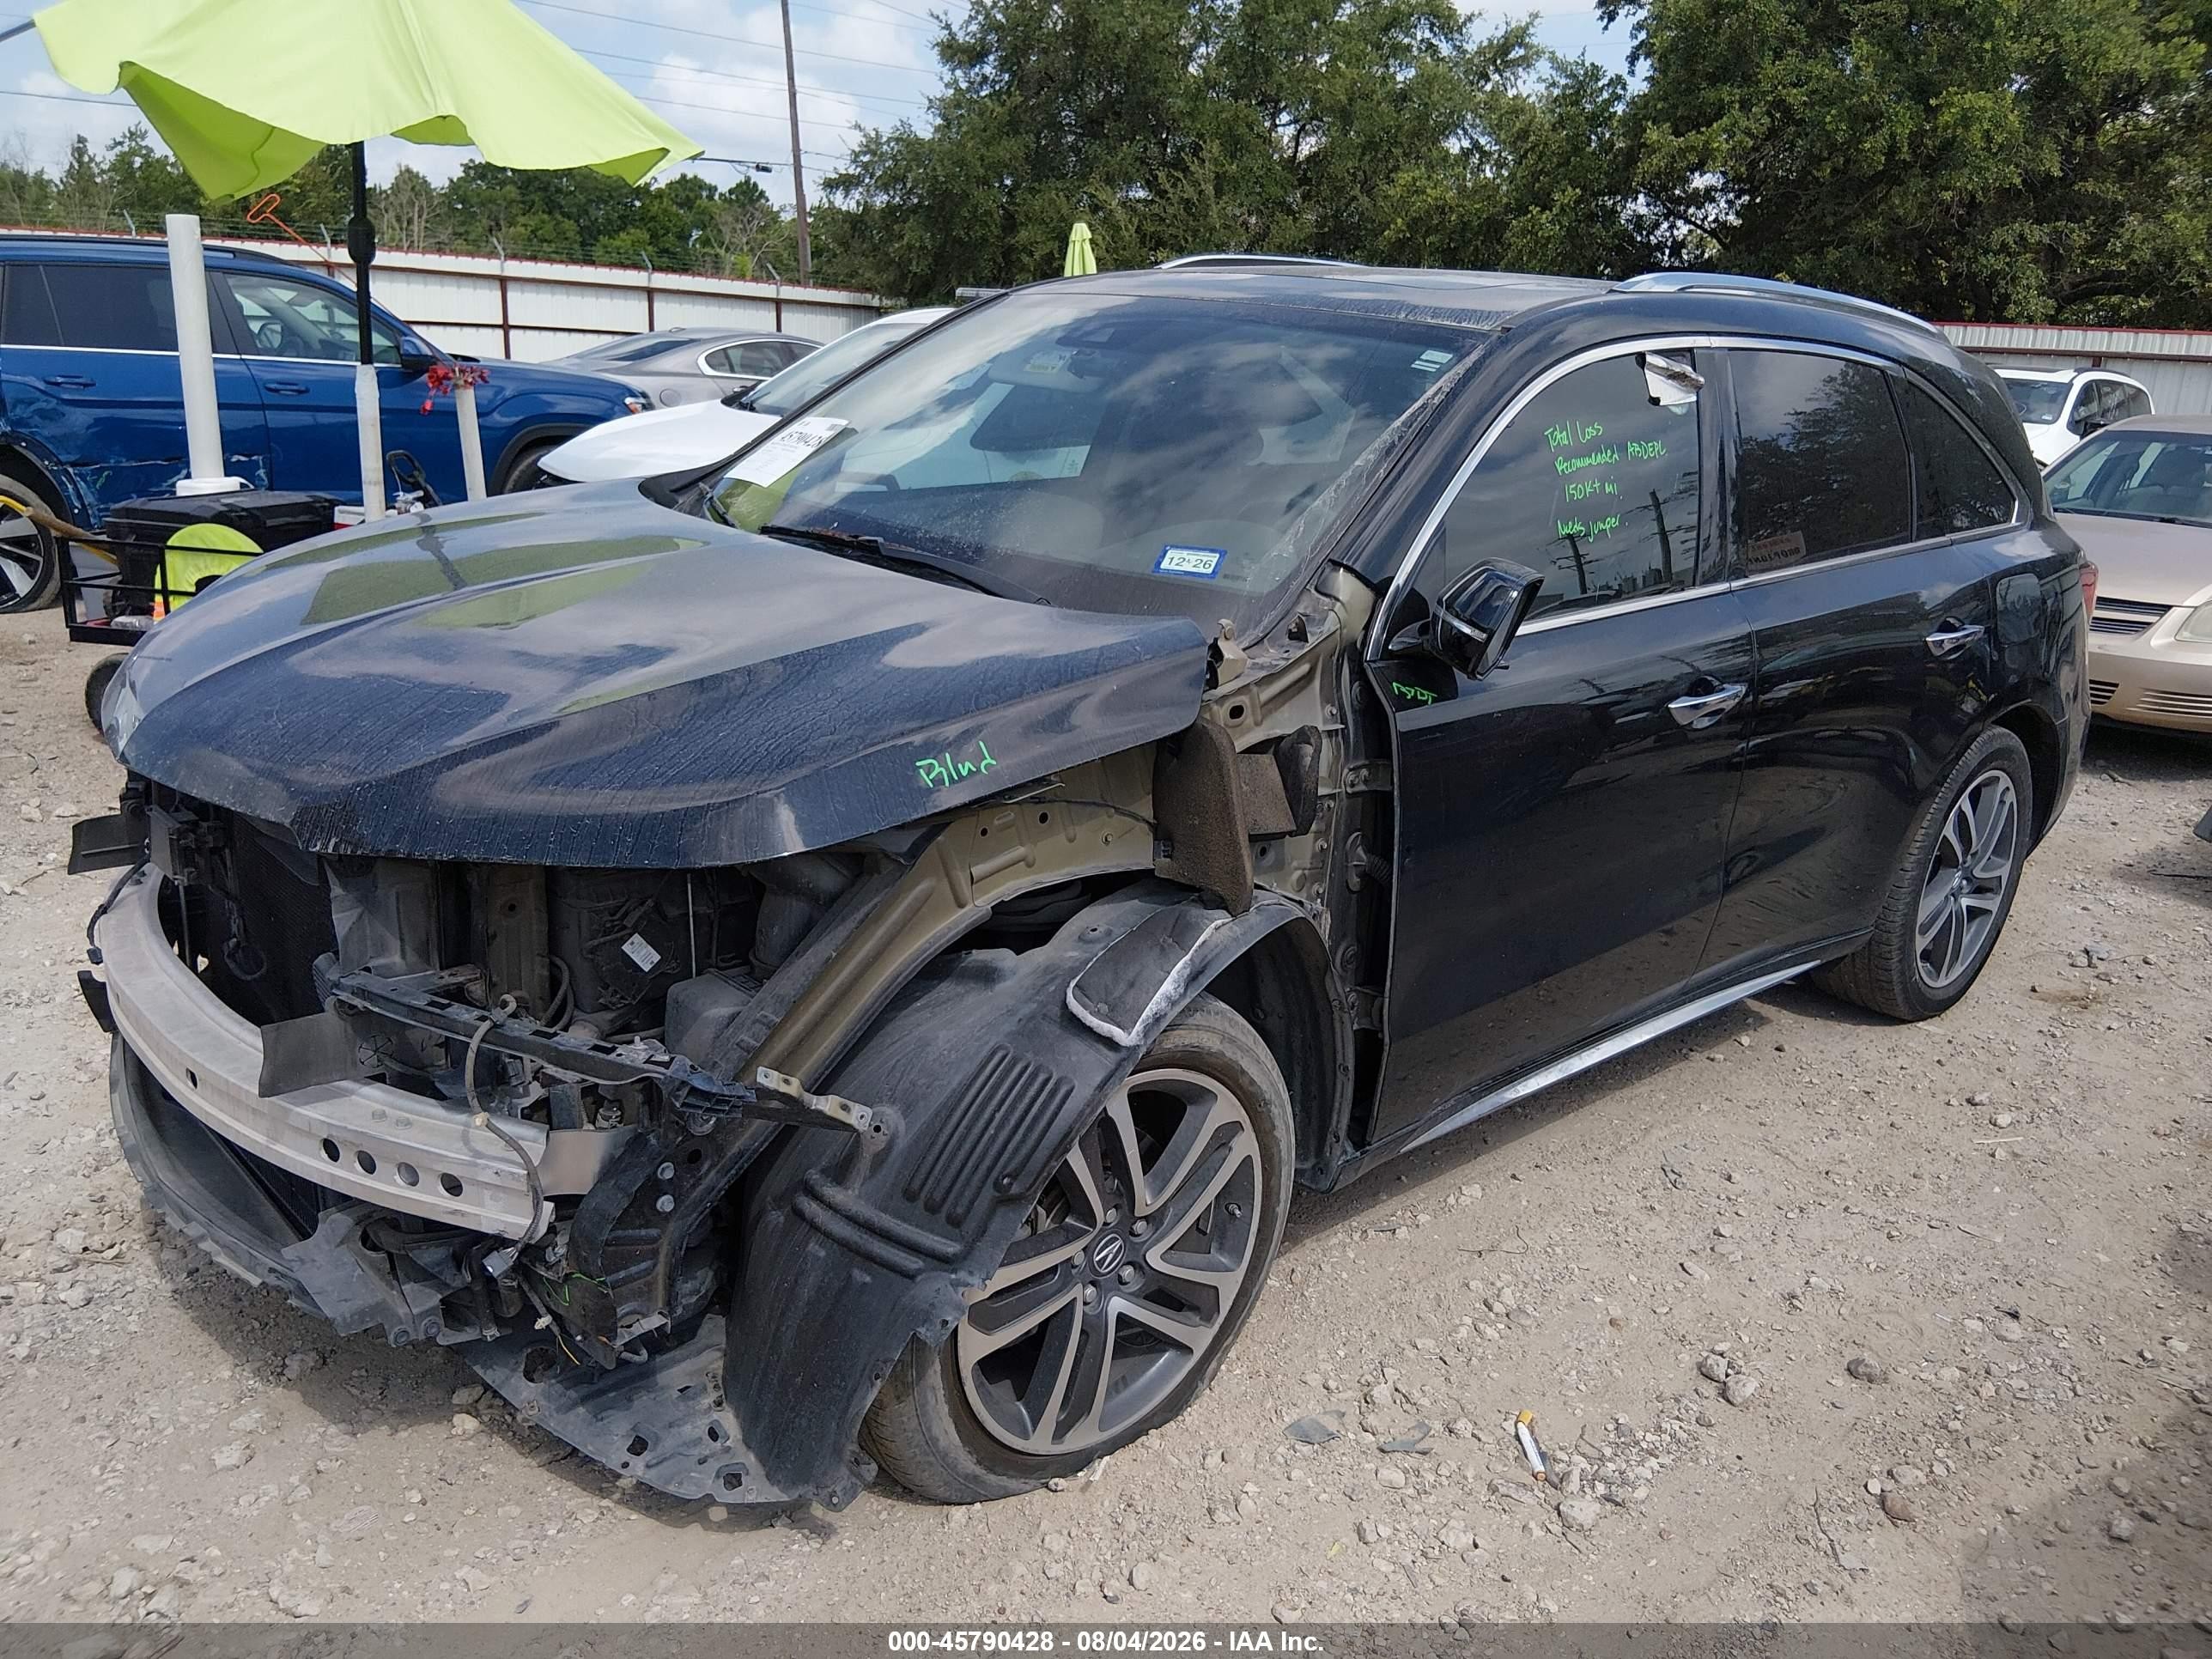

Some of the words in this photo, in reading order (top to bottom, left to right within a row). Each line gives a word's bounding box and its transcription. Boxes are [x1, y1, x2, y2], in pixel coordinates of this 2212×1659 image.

[1544, 421, 1572, 453] Total
[1576, 421, 1602, 443] Loss
[1167, 556, 1186, 567] 12
[1192, 558, 1214, 570] 26
